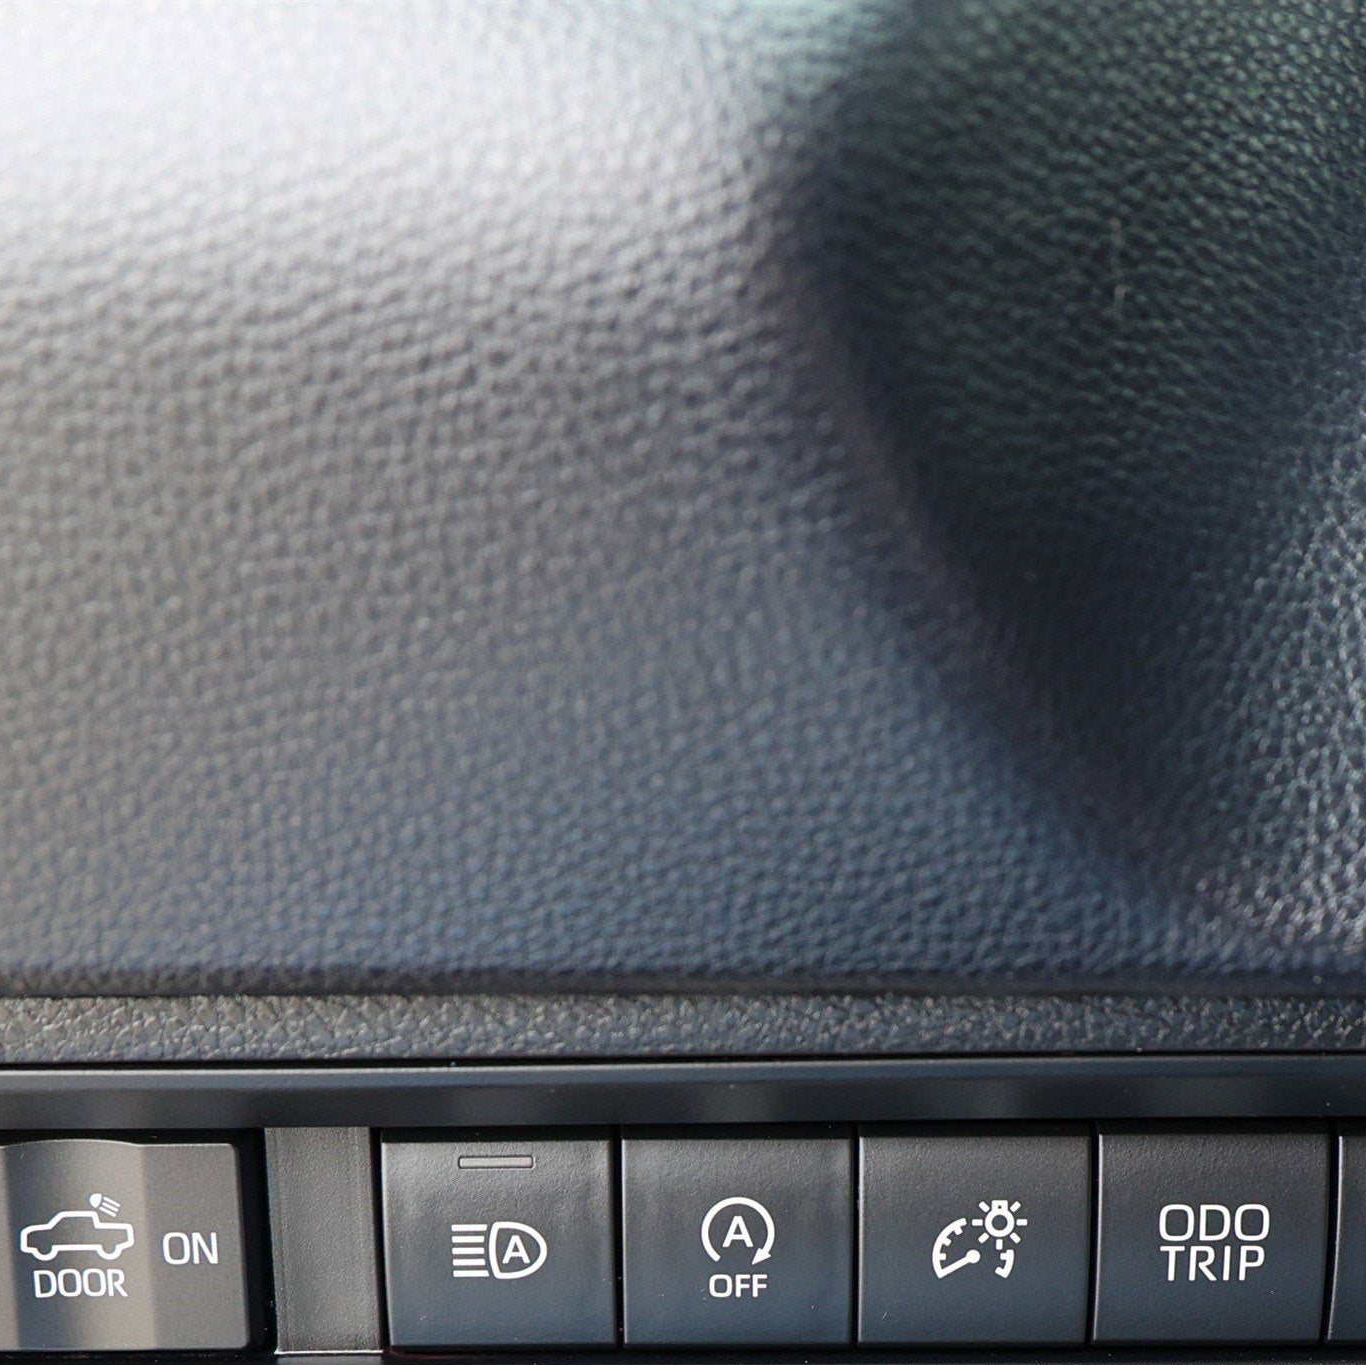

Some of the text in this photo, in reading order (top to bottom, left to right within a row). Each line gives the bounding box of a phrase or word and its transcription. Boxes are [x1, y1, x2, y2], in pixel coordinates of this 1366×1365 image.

[722, 1215, 754, 1248] A
[1159, 1203, 1270, 1242] ODO
[162, 1232, 219, 1265] ON
[1159, 1245, 1265, 1281] TRIP
[33, 1268, 128, 1298] DOOR
[708, 1273, 768, 1298] OFF
